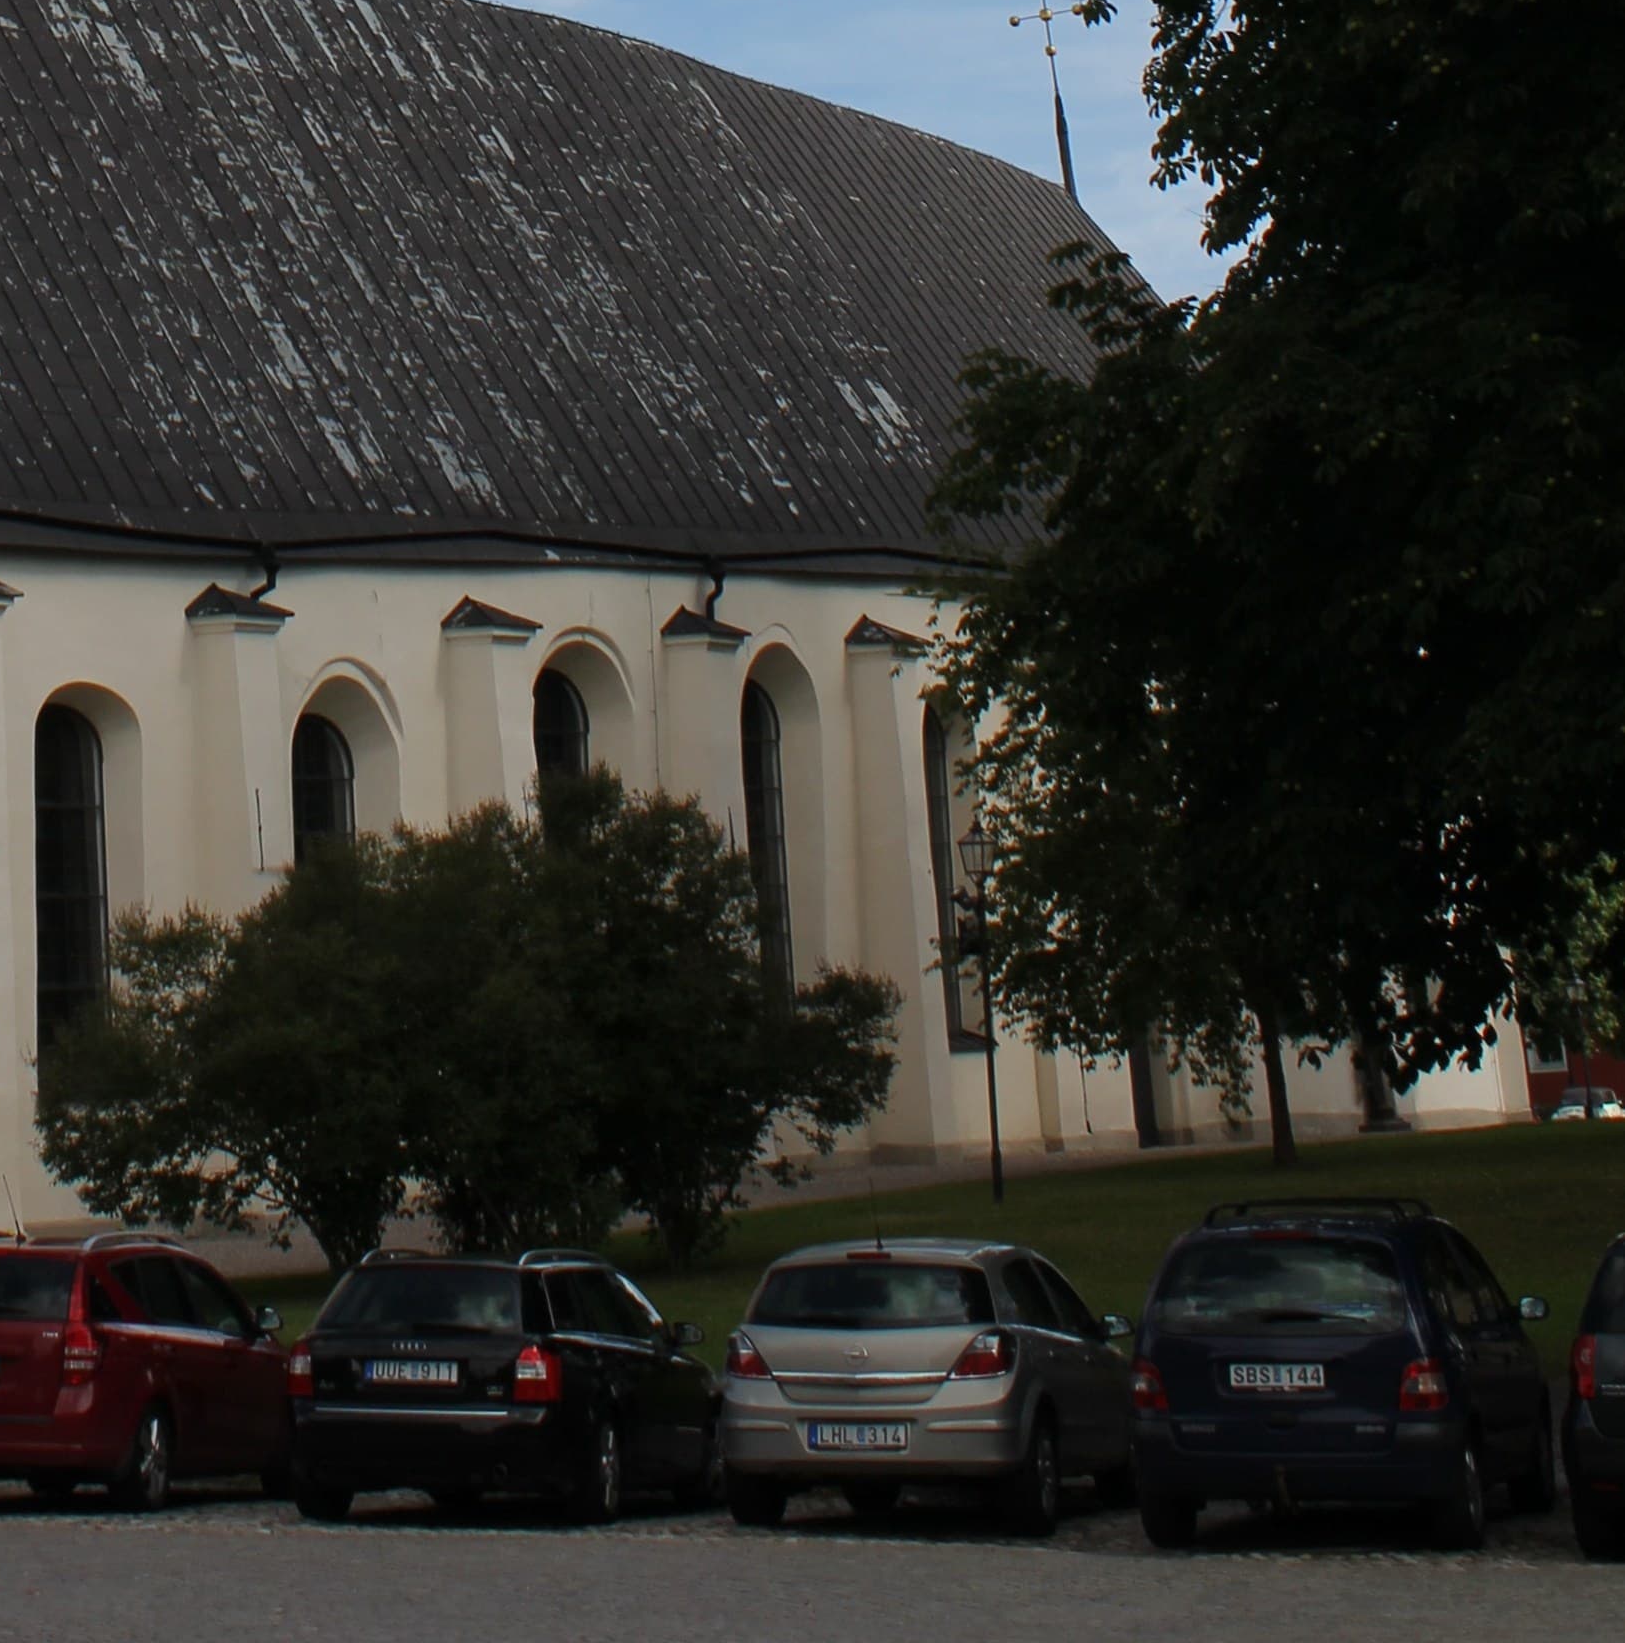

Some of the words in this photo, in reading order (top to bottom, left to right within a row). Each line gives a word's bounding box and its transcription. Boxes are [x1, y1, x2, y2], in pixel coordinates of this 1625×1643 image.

[375, 1361, 407, 1379] UUE
[421, 1362, 453, 1380] 911
[1233, 1366, 1271, 1384] SBS
[1285, 1366, 1321, 1384] 144
[819, 1426, 853, 1444] LHL
[868, 1426, 901, 1444] 314
